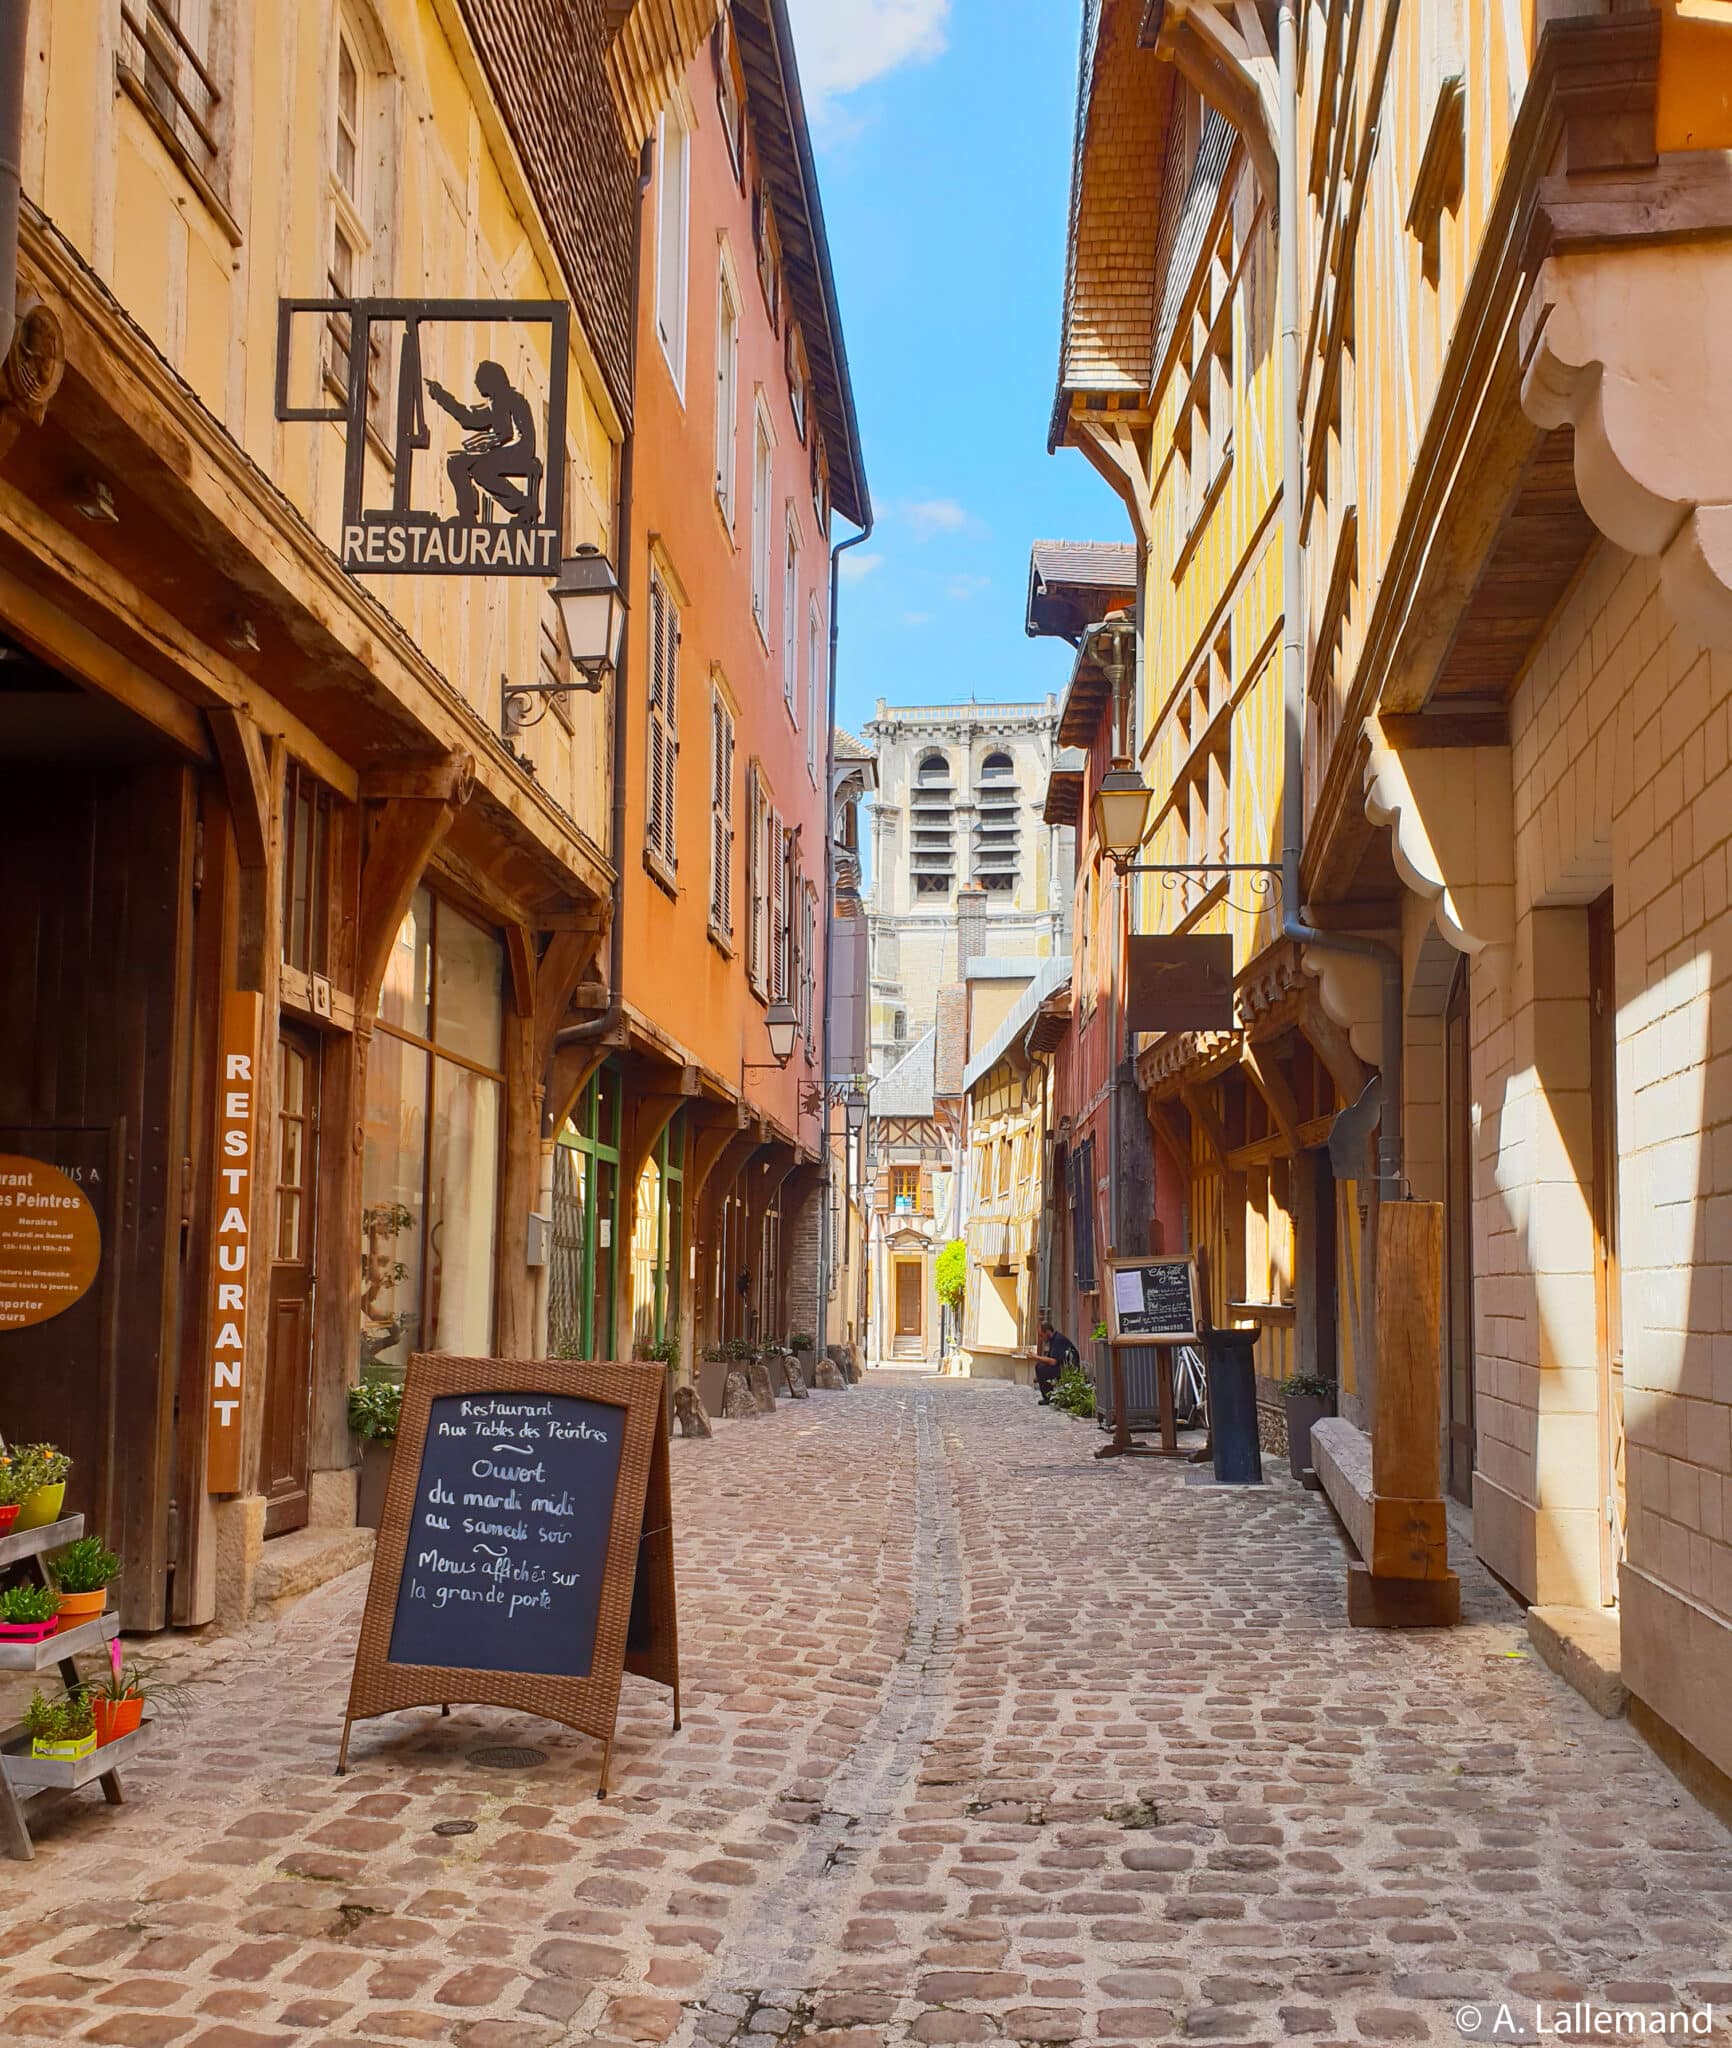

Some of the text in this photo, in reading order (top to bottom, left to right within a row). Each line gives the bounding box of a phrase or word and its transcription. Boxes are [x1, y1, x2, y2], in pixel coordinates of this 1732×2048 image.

[343, 525, 557, 566] RESTAURANT
[0, 1172, 33, 1186] rant
[16, 1192, 81, 1209] Peintres
[214, 1054, 252, 1427] RESTAURANT
[460, 1400, 553, 1417] Restaurant
[438, 1420, 608, 1443] Aux Tables des Peintres
[472, 1459, 546, 1483] Ouvert
[428, 1478, 575, 1516] du mardi midi
[425, 1512, 573, 1544] au samedi soir
[418, 1549, 581, 1586] Menus affichés sur
[410, 1578, 552, 1618] la grande porte
